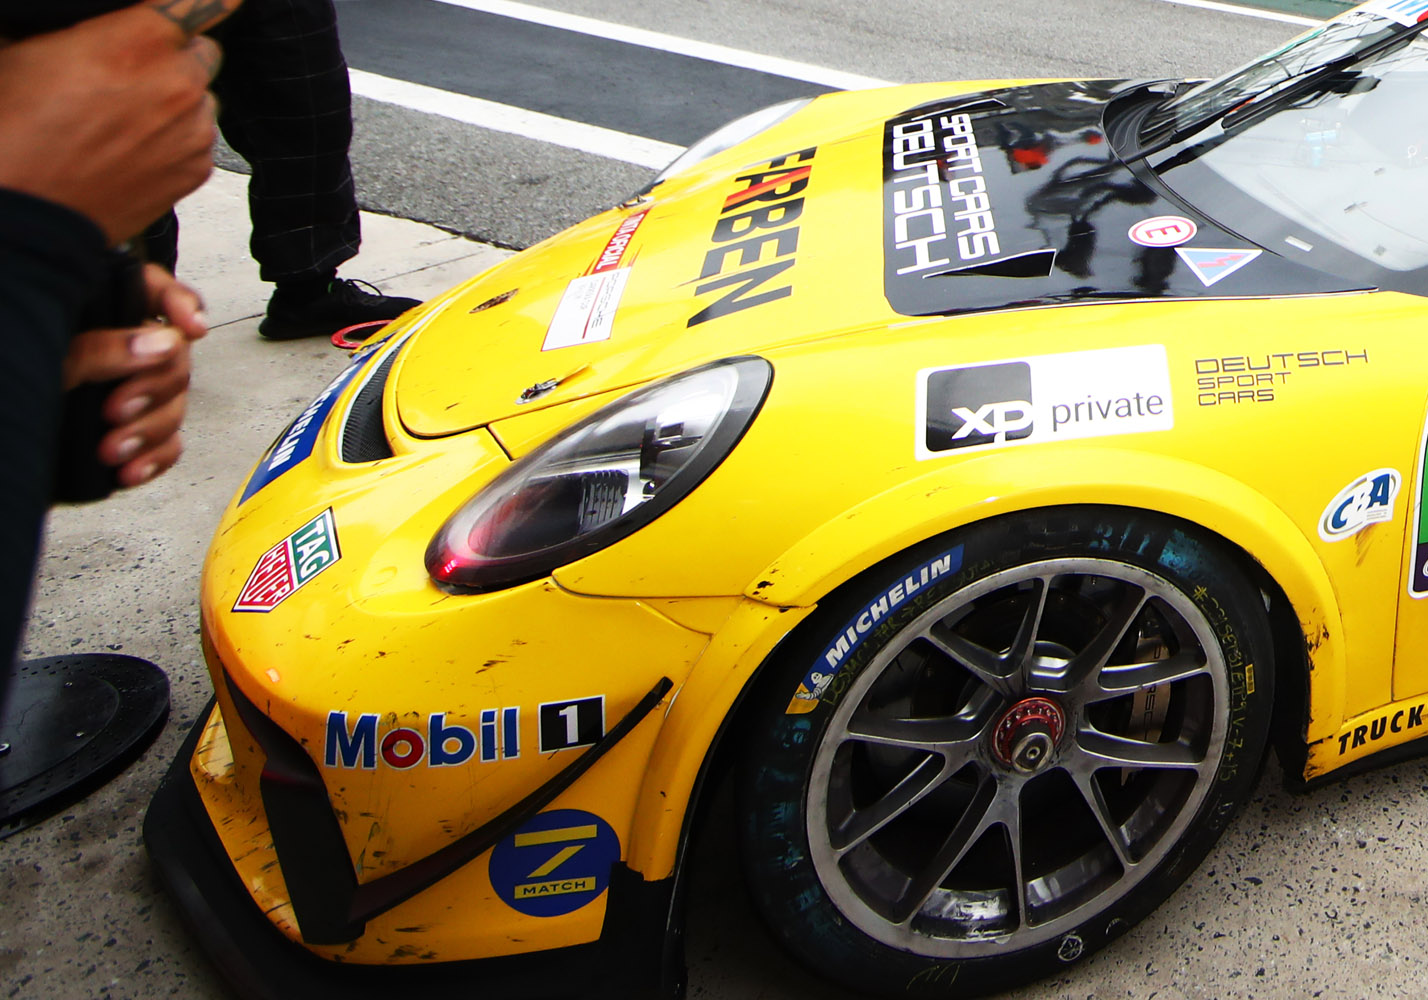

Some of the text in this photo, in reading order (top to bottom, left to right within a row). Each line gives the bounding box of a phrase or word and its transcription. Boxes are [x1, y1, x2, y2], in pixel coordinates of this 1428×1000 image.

[893, 119, 950, 275] DEUTSCH
[940, 113, 1000, 260] SPORT CARS
[687, 146, 817, 328] FARBEN
[1195, 348, 1369, 374] DEUTSCH
[1197, 371, 1291, 391] SPORT
[1052, 391, 1164, 432] private
[1198, 388, 1275, 407] CARS
[1332, 473, 1390, 529] CBA
[242, 544, 291, 603] HEUER
[295, 518, 330, 579] TAG
[825, 554, 951, 668] MICHELIN
[322, 704, 521, 771] Mobil
[523, 880, 587, 896] MATCH
